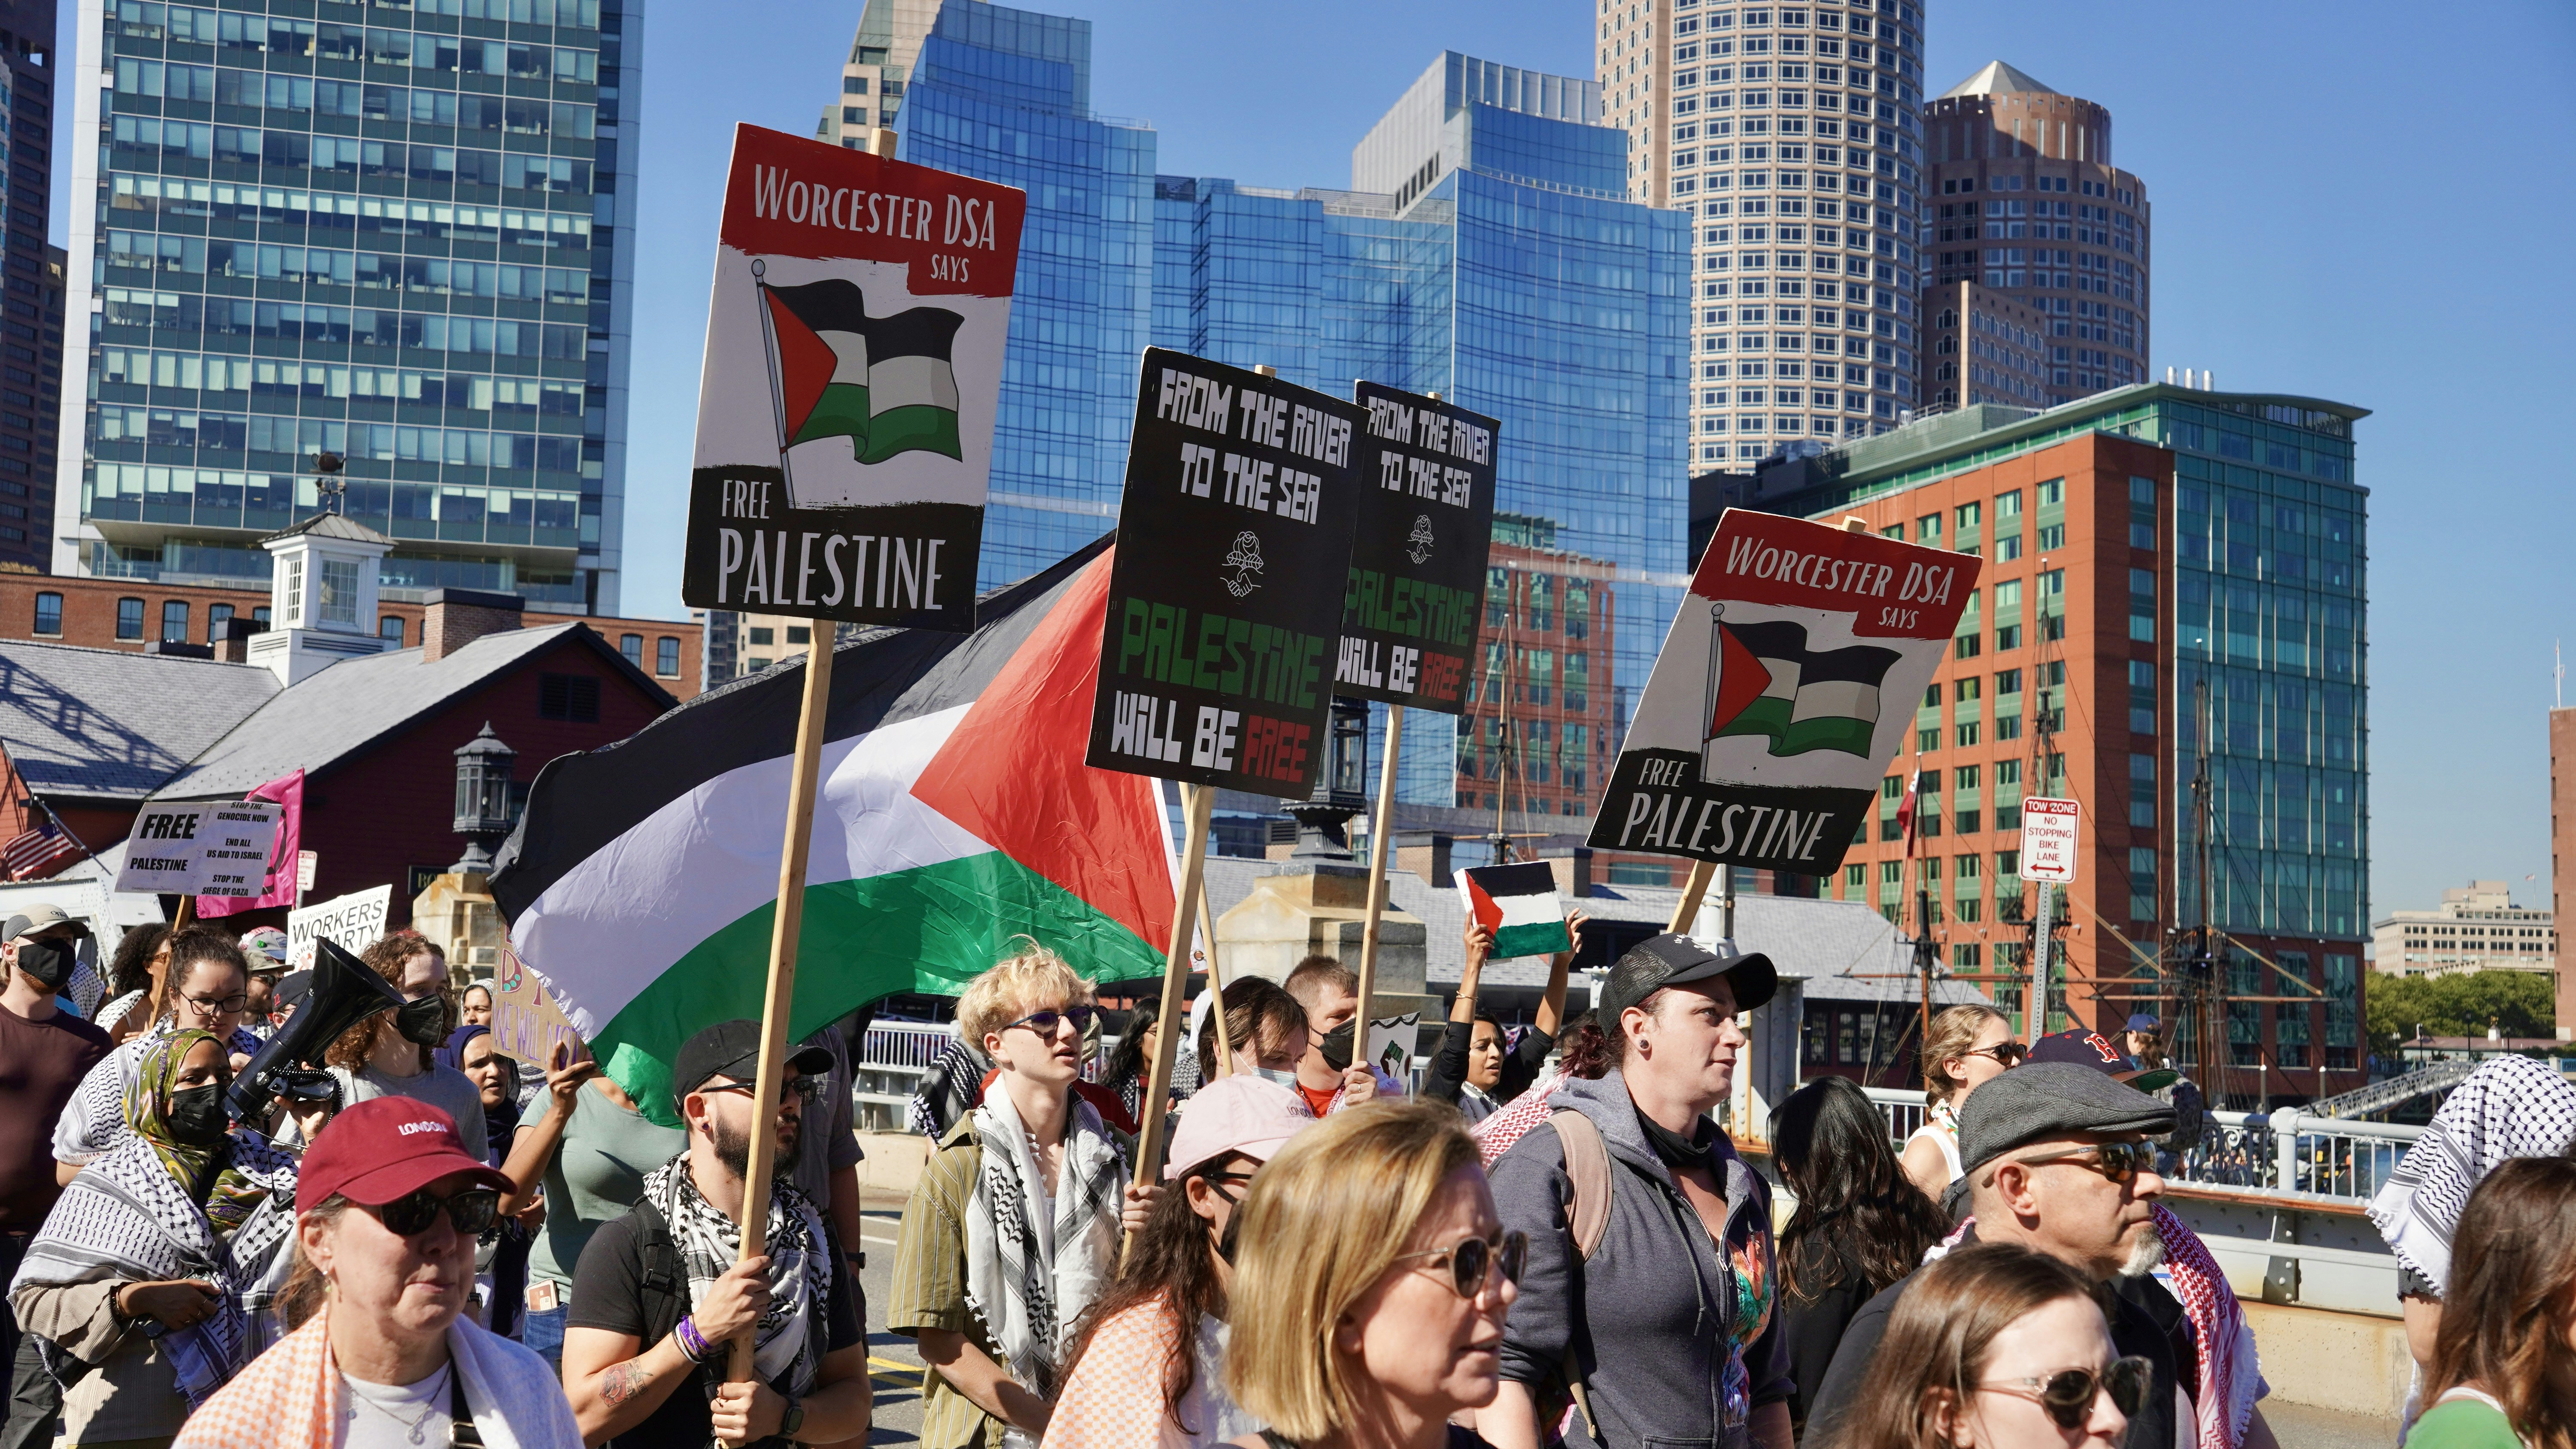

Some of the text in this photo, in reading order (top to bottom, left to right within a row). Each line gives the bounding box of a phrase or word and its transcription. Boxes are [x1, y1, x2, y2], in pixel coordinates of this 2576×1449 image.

[755, 164, 996, 251] WORCESTER DSA
[931, 254, 969, 283] SAYS
[1157, 368, 1233, 435] FROM
[1240, 389, 1288, 449] THE
[1367, 396, 1413, 444] FROM
[1419, 409, 1449, 453] THE
[1180, 442, 1321, 525] TO THE SEA
[1381, 451, 1471, 509] TO THE SEA
[722, 479, 772, 520] FREE
[718, 528, 946, 610] PALESTINE
[1725, 535, 1954, 606] WORCESTER DSA
[1878, 606, 1920, 630] SAYS
[1388, 646, 1419, 693] BE
[1419, 652, 1464, 701] FREE
[1191, 706, 1240, 771] BE
[1244, 715, 1311, 784] FREE
[1638, 758, 1688, 788] FREE
[217, 812, 251, 822] GENOCIDE
[2028, 801, 2076, 813] TOW ZONE
[2044, 817, 2057, 825] NO
[140, 814, 199, 840] FREE
[1619, 793, 1835, 860] PALESTINE
[2028, 827, 2072, 838] STOPPING
[2037, 852, 2060, 861] LANE
[2039, 840, 2059, 849] BIKE
[130, 858, 188, 871] PALESTINE
[213, 875, 231, 883] STOP
[307, 906, 334, 919] WORKING
[336, 899, 355, 909] CLASS
[357, 895, 378, 903] NEEDS
[293, 900, 383, 944] WORKERS
[325, 922, 380, 950] ARTY
[494, 998, 580, 1070] WE WILL NOT
[2084, 1033, 2120, 1063] B
[1287, 1106, 1315, 1119] LONDON
[398, 1121, 448, 1136] LONDON
